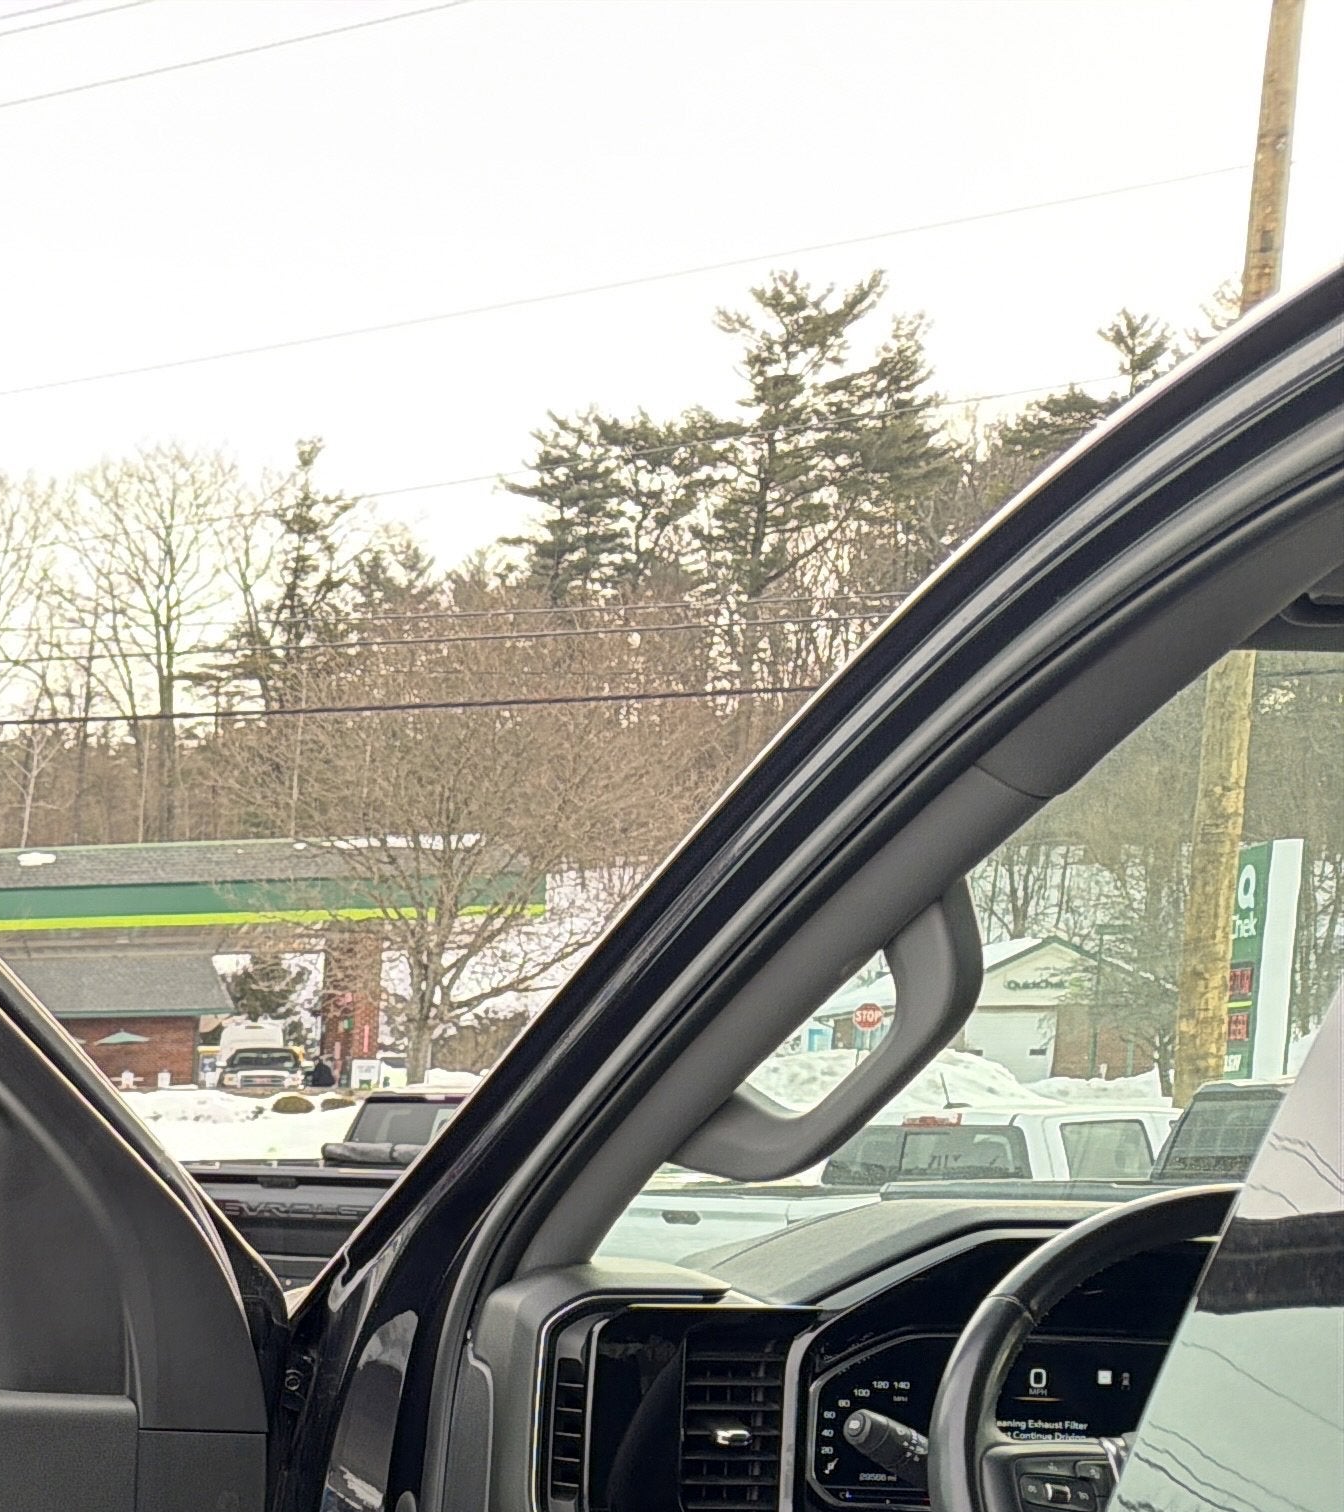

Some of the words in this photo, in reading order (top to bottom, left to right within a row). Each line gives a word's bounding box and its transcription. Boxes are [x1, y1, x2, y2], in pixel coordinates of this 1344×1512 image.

[855, 1010, 882, 1022] STOP
[1029, 1368, 1047, 1388] 0
[872, 1380, 890, 1389] 120
[893, 1381, 910, 1389] 140
[853, 1388, 870, 1397] 100
[1029, 1388, 1047, 1396] MPH
[823, 1411, 836, 1419] 60
[996, 1420, 1026, 1431] eaning
[1028, 1419, 1063, 1430] Exhaust
[1064, 1421, 1089, 1430] Filter
[821, 1429, 834, 1437] 40
[1013, 1431, 1052, 1440] Continue
[821, 1446, 834, 1454] 20
